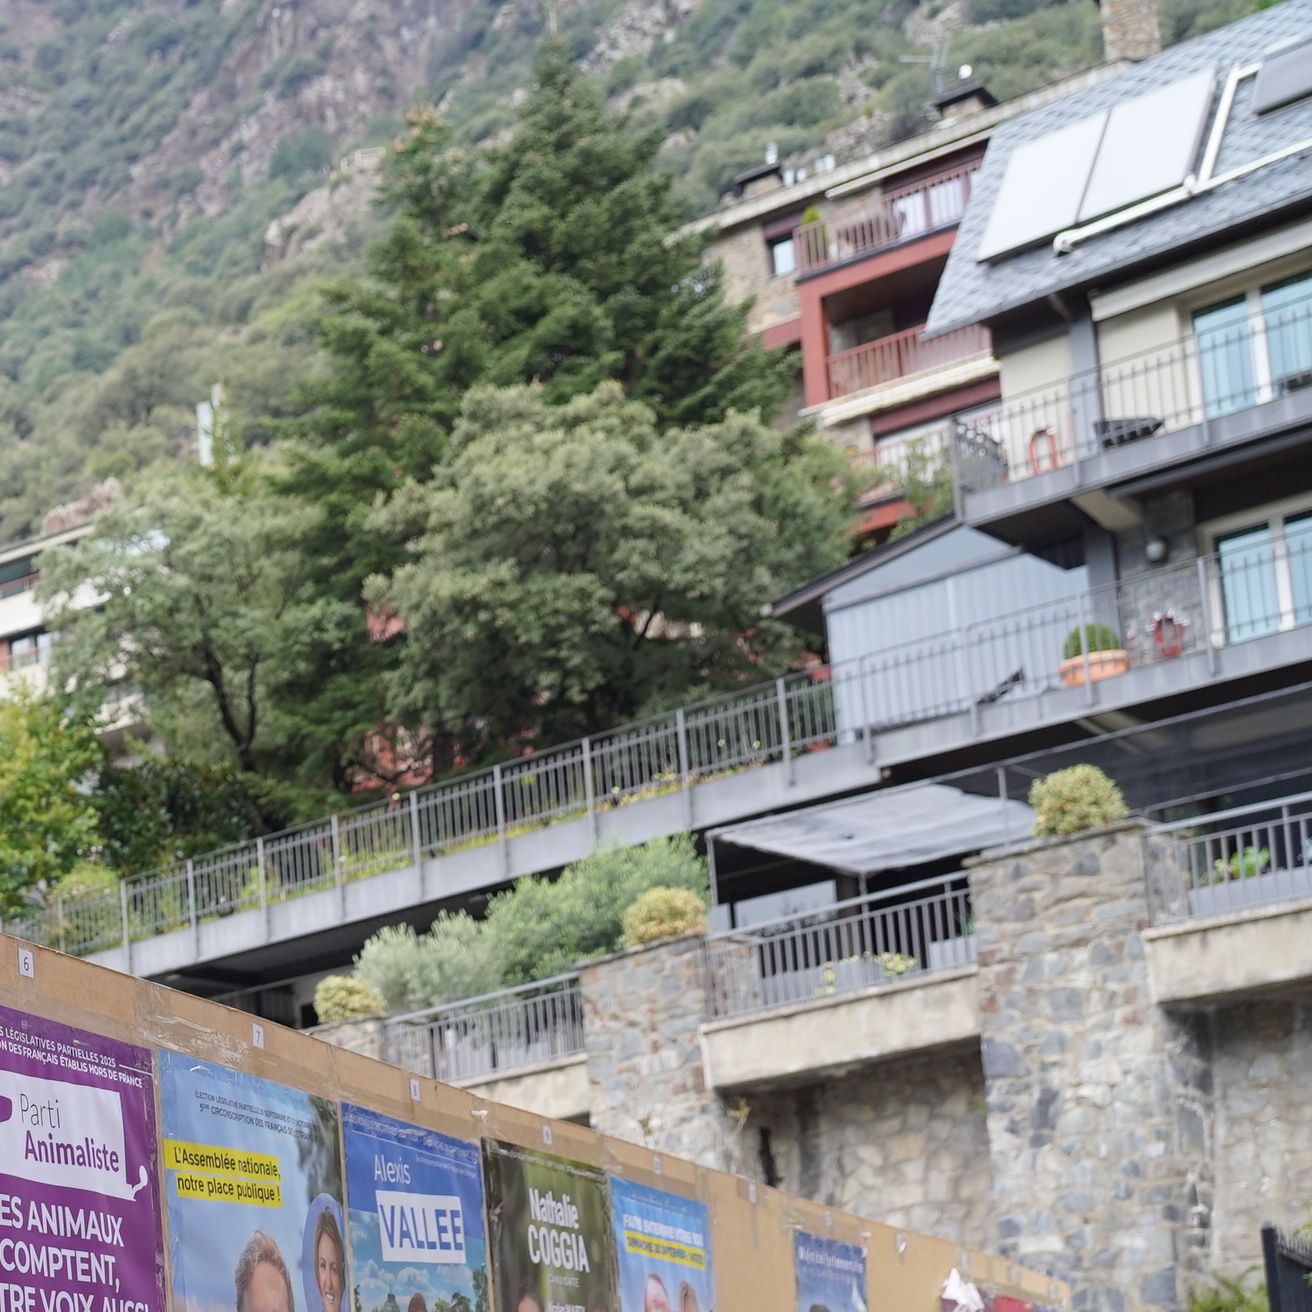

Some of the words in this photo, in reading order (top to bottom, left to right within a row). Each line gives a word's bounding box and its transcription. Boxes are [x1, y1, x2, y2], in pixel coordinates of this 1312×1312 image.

[22, 957, 30, 972] 6
[5, 1027, 56, 1051] LÉGISLATIVES
[57, 1041, 98, 1062] PARTIELLES
[100, 1055, 116, 1067] 2025
[256, 1031, 261, 1043] 7
[9, 1042, 22, 1055] DES
[23, 1046, 58, 1065] FRANÇAIS
[60, 1054, 88, 1072] ÉTABLIS
[89, 1063, 108, 1078] HORS
[108, 1069, 118, 1080] DE
[118, 1072, 143, 1088] FRANCE
[20, 1093, 61, 1129] Parti
[25, 1130, 119, 1173] Animaliste
[174, 1147, 236, 1170] L'Assemblée
[238, 1159, 281, 1179] nationale,
[375, 1155, 411, 1184] Alexis
[177, 1177, 204, 1193] notre
[208, 1179, 234, 1197] place
[237, 1183, 275, 1203] publique
[529, 1188, 579, 1229] Nathalie
[27, 1201, 124, 1247] ANIMAUX
[380, 1205, 463, 1250] VALLEE
[528, 1224, 590, 1273] COGGIA
